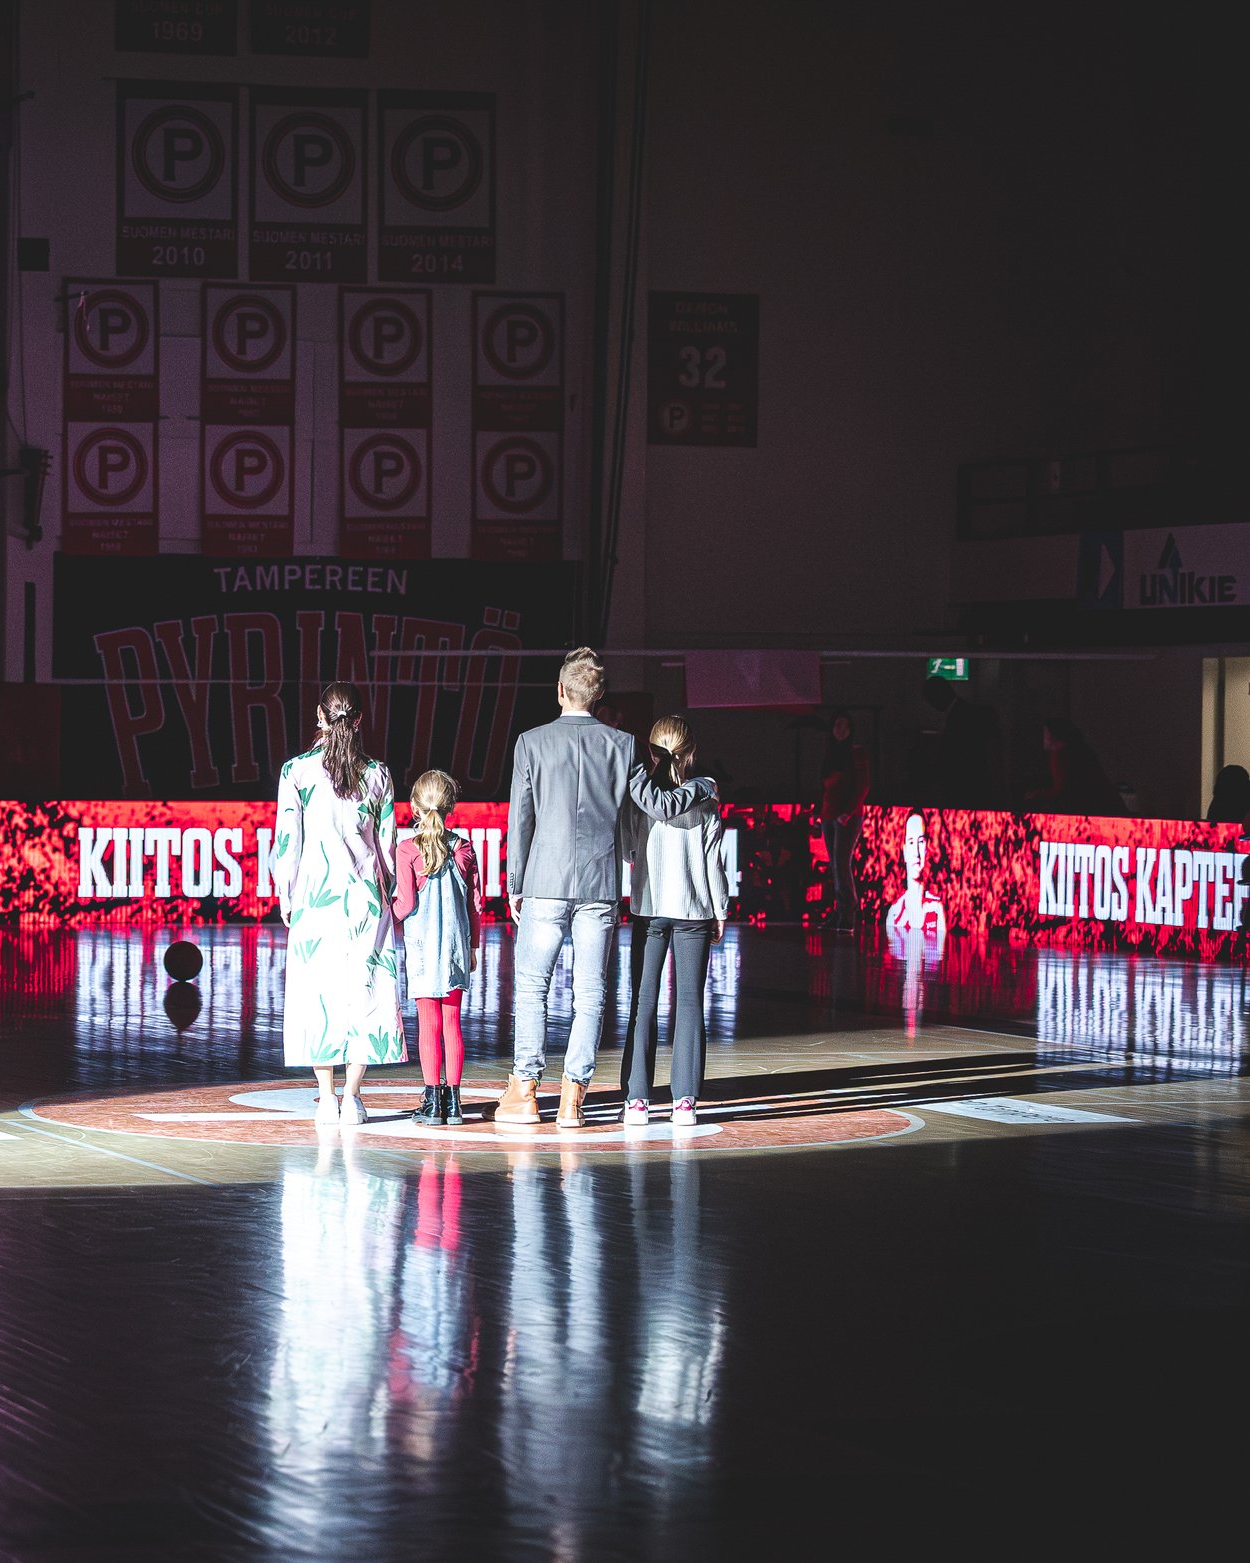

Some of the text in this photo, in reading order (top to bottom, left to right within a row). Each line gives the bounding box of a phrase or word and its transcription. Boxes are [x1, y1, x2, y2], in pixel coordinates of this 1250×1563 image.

[150, 20, 203, 42] 1969
[285, 24, 339, 46] 2012
[163, 128, 203, 182] P
[293, 134, 333, 188] P
[421, 137, 461, 190] P
[121, 226, 236, 241] SUOMEN MESTARI
[253, 230, 307, 244] SUOMEN
[152, 246, 206, 267] 2010
[285, 250, 333, 272] 2011
[411, 253, 464, 273] 2014
[99, 308, 131, 351] P
[236, 313, 268, 356] P
[373, 317, 406, 360] P
[507, 320, 538, 363] P
[678, 345, 727, 389] 32
[97, 445, 130, 490] P
[235, 449, 267, 493] P
[374, 451, 405, 495] P
[506, 454, 536, 497] P
[213, 564, 409, 596] TAMPEREEN
[93, 606, 522, 800] PYRINTÖ
[78, 827, 243, 898] KIITOS
[1038, 840, 1130, 922] KIITOS
